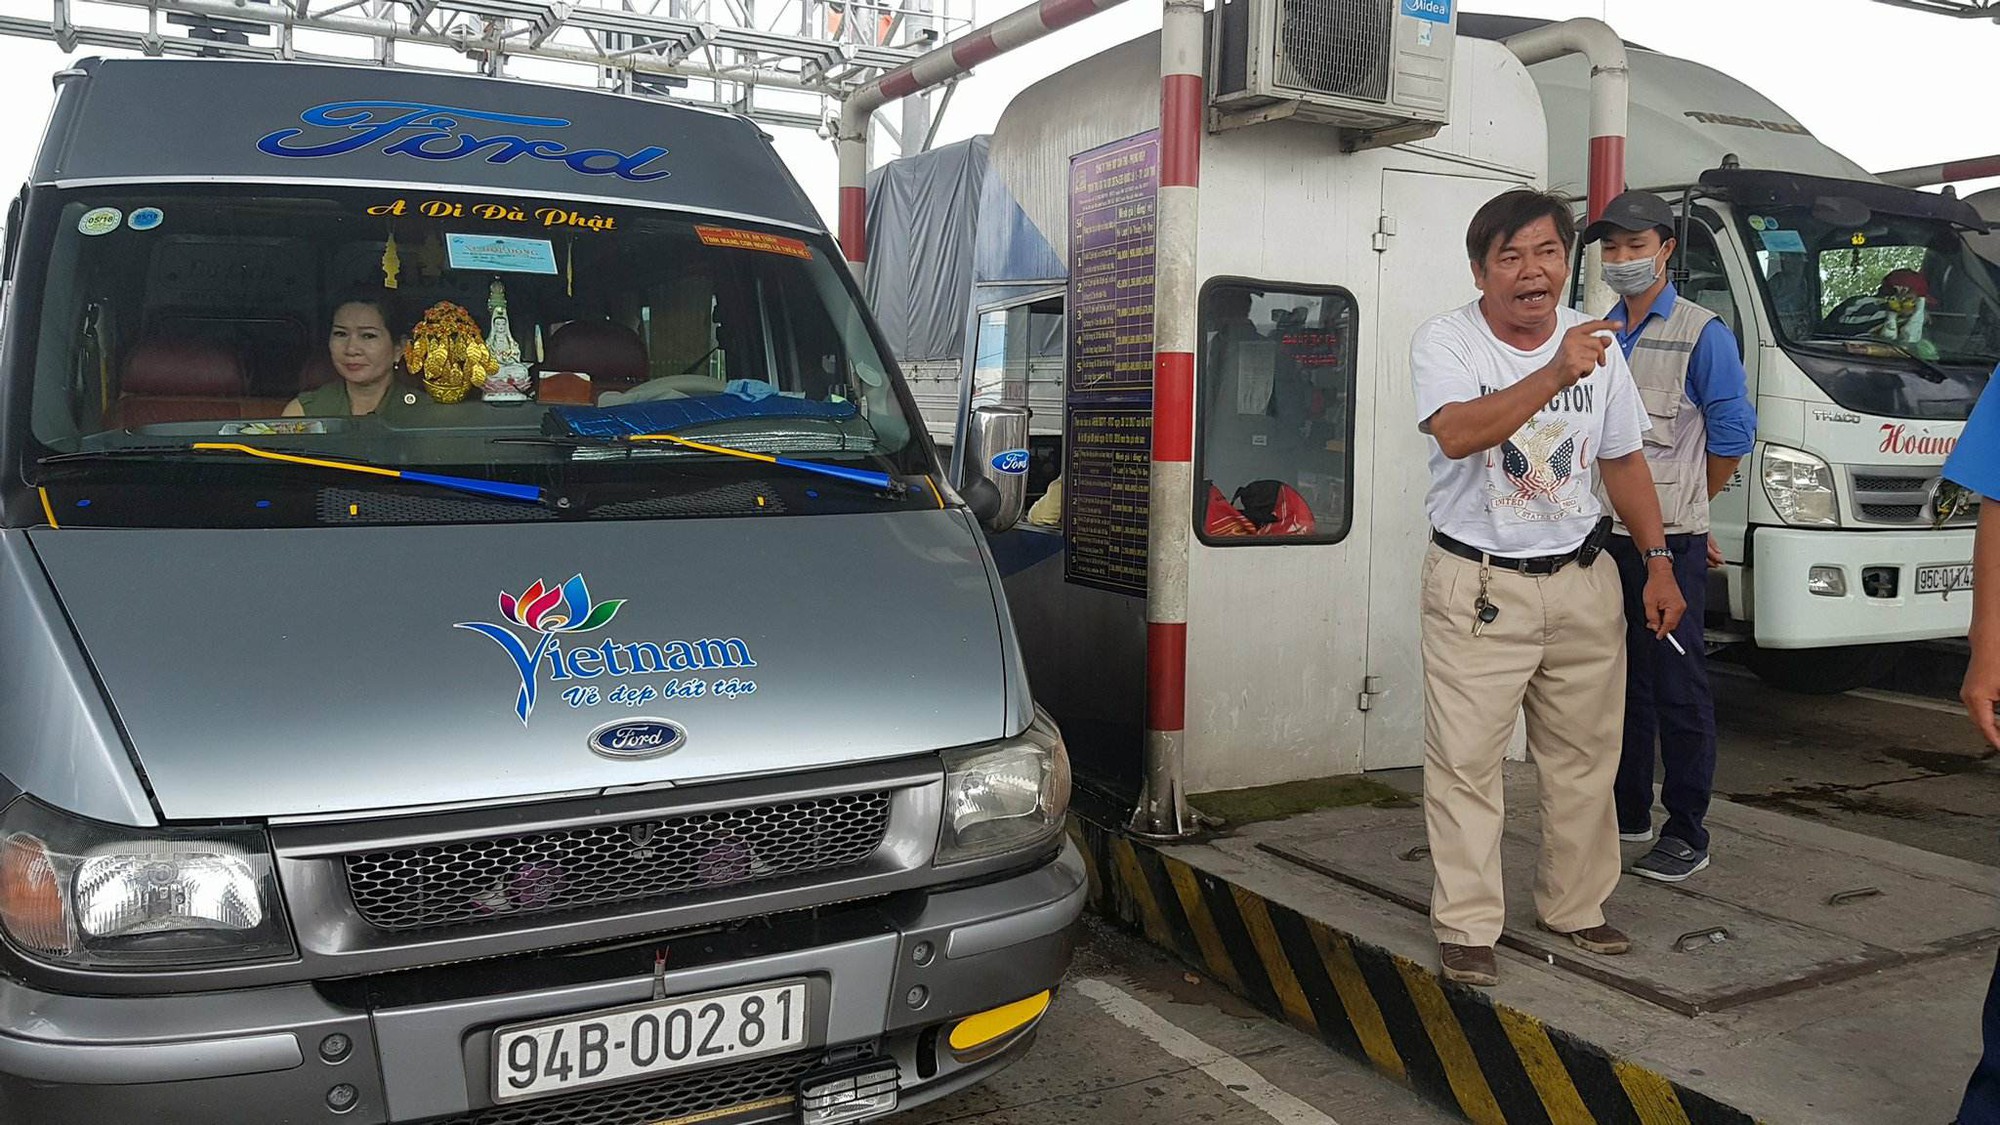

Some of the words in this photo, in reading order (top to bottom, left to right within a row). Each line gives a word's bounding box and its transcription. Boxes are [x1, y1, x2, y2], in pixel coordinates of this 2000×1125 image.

[1406, 0, 1445, 15] Midea
[256, 100, 671, 182] Ford
[88, 215, 114, 224] 05/18
[366, 199, 407, 216] A
[420, 200, 465, 218] Di
[472, 203, 528, 221] Đà
[535, 207, 618, 231] Phật
[1077, 257, 1082, 268] 1
[1076, 283, 1082, 293] 2
[1076, 310, 1082, 320] 3
[1076, 336, 1082, 346] 4
[1076, 362, 1082, 373] 5
[1812, 409, 1861, 424] THACO
[1002, 453, 1027, 470] Ford
[453, 622, 757, 728] Vietnam
[562, 686, 601, 708] Vẻ
[608, 683, 656, 707] đẹp
[663, 678, 706, 700] bất
[713, 677, 757, 700] tận
[611, 725, 663, 749] Ford
[507, 989, 792, 1089] 94B-002.81
